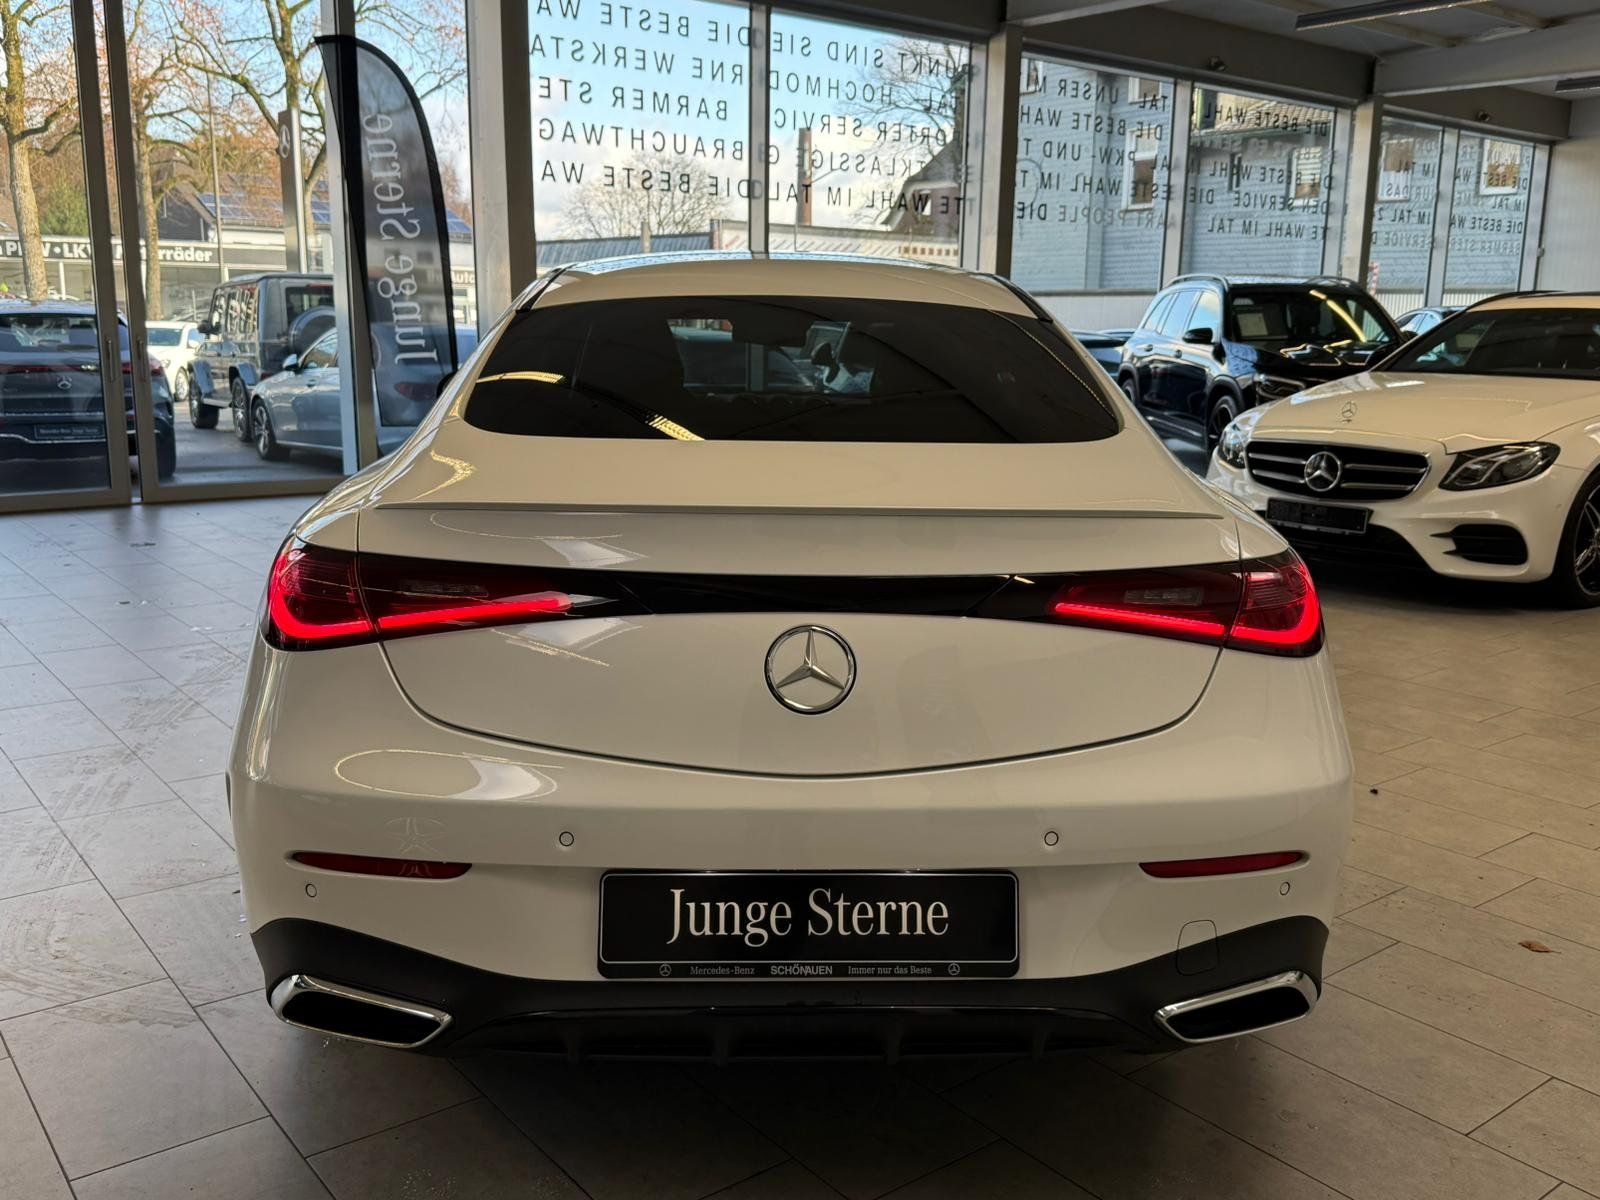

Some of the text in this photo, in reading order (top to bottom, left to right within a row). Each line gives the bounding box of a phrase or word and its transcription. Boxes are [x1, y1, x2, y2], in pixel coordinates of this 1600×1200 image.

[63, 242, 92, 259] LK
[666, 886, 950, 948] Junge Sterne
[690, 965, 755, 975] Mercedes-Benz
[848, 965, 877, 975] Immer
[877, 966, 893, 975] nur
[894, 965, 909, 975] das
[910, 965, 933, 975] Beste
